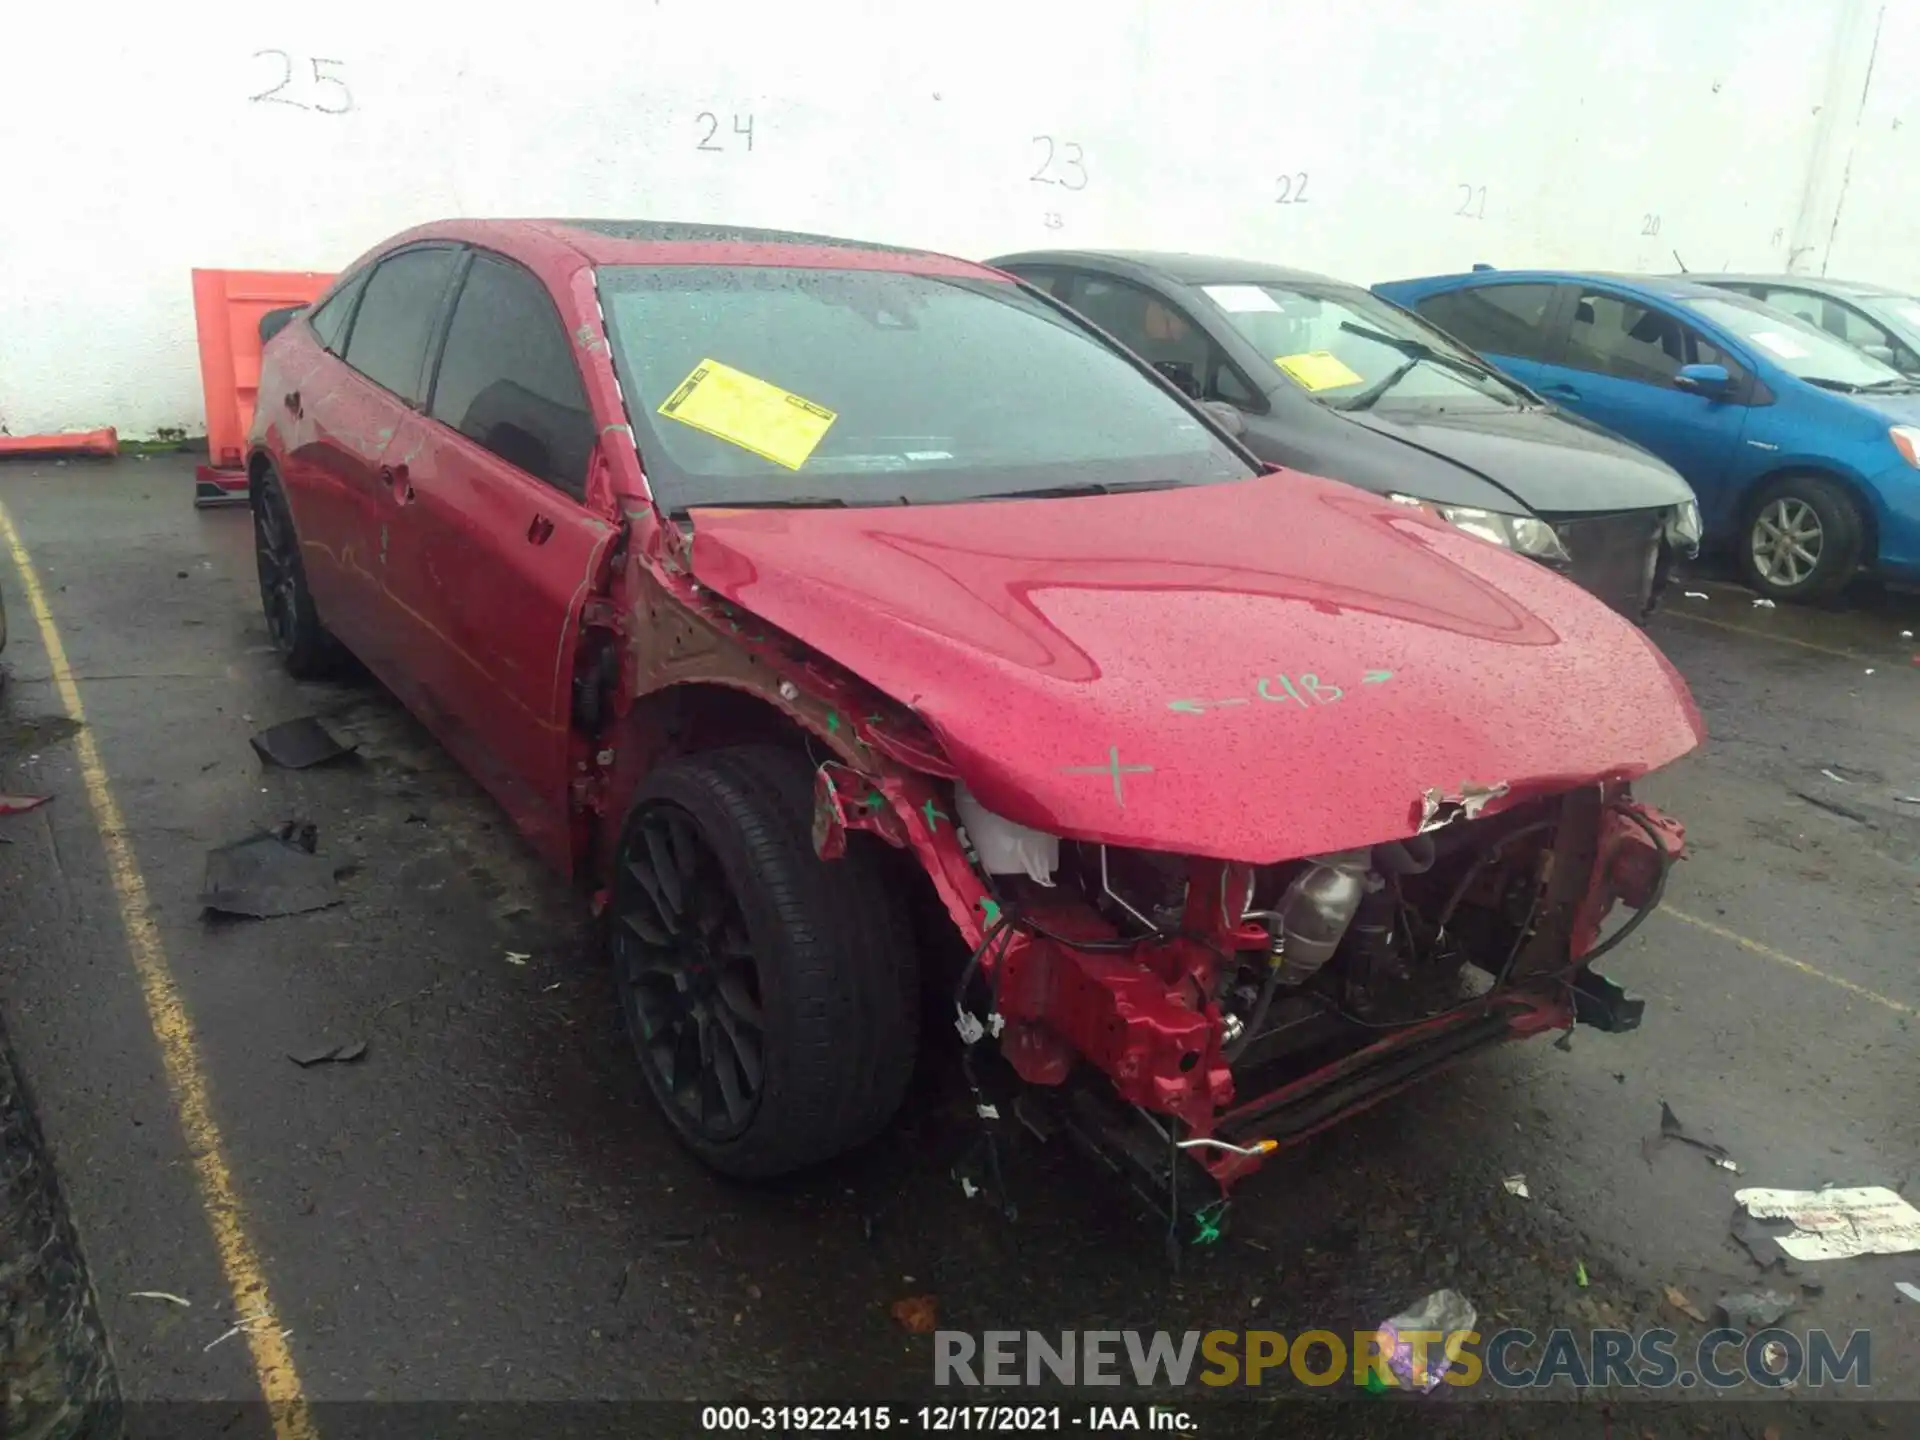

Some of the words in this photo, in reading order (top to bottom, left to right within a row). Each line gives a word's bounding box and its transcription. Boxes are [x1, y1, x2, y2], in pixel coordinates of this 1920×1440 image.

[249, 49, 354, 114] 25
[695, 111, 754, 152] 24
[1029, 134, 1089, 191] 23
[1274, 171, 1309, 204] 22
[1453, 183, 1487, 220] 21
[1640, 212, 1661, 236] 20
